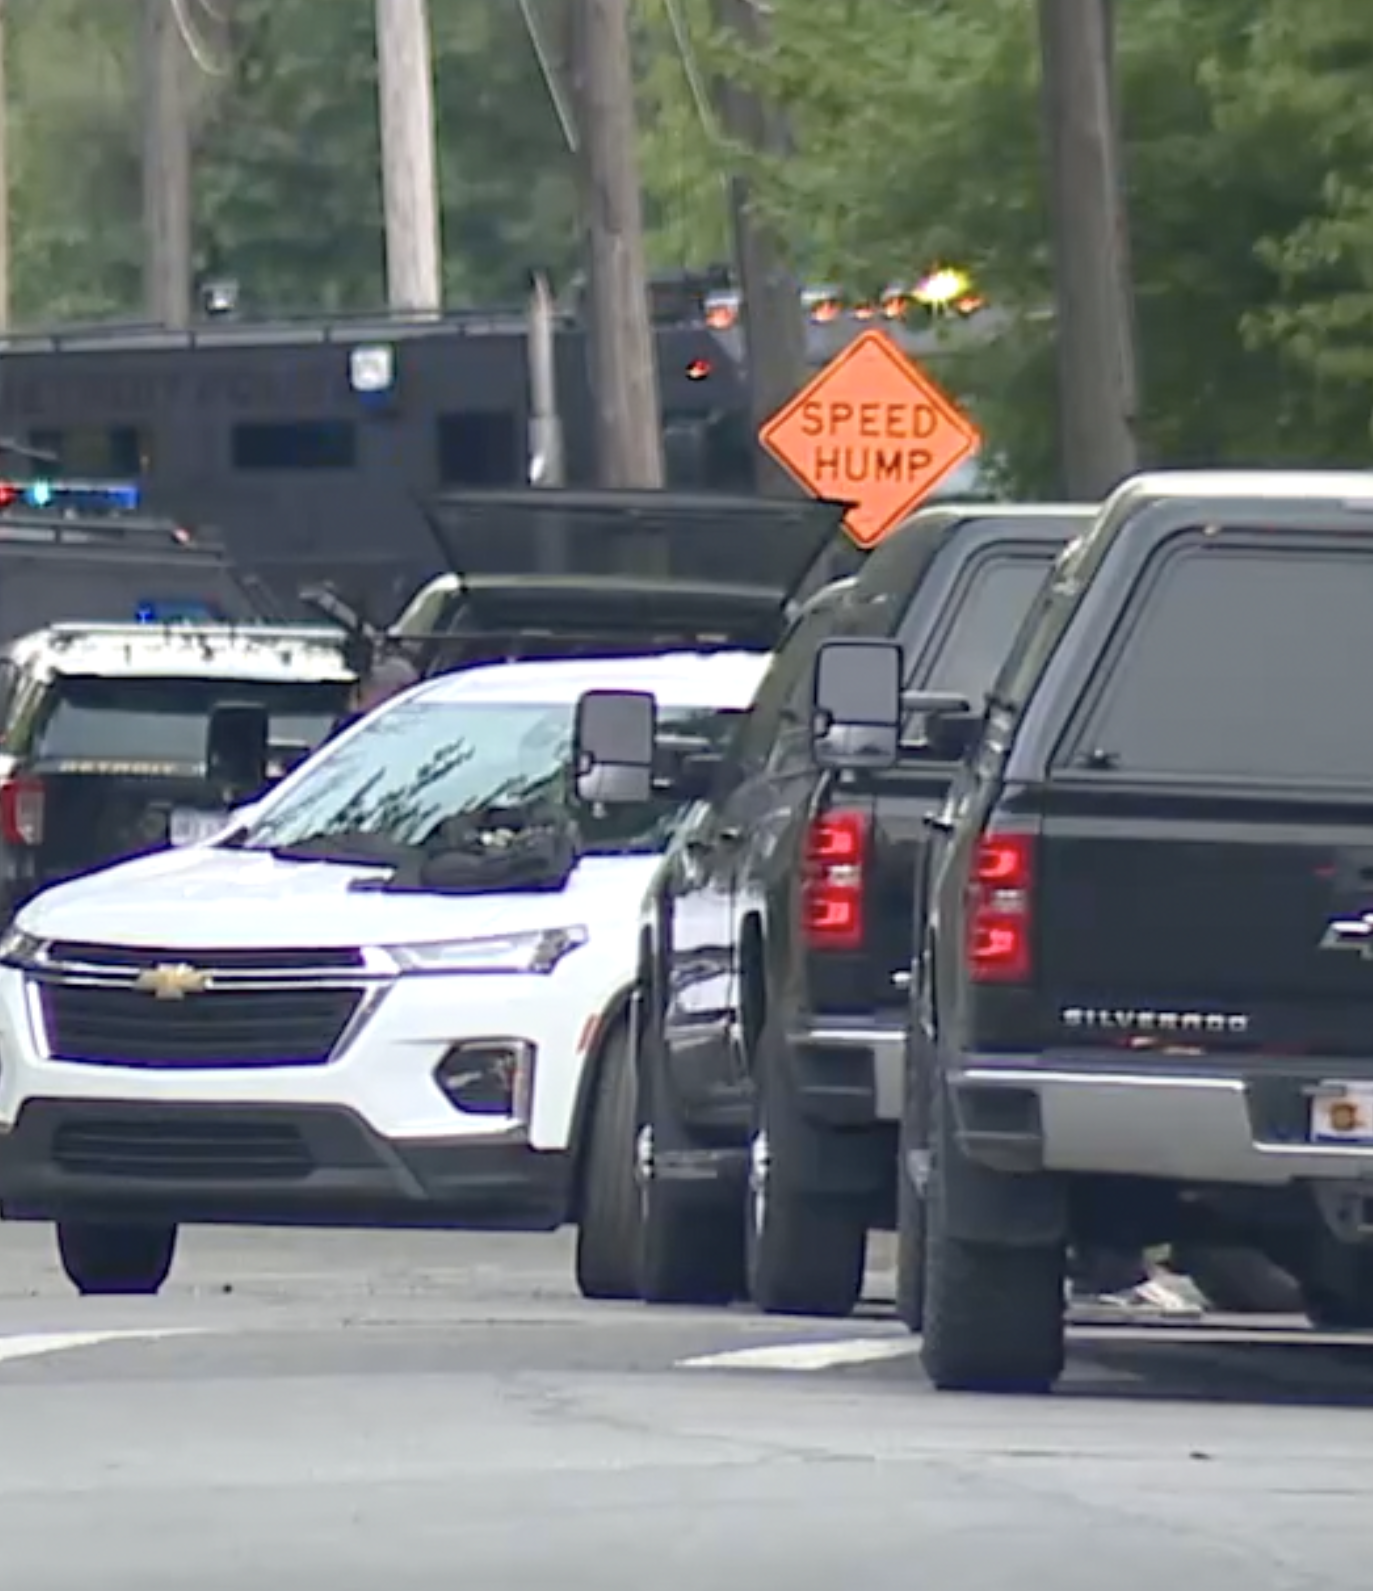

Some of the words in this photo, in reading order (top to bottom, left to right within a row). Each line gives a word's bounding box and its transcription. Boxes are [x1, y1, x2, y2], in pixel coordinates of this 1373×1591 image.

[800, 401, 938, 439] SPEED
[814, 446, 933, 483] HUMP
[1062, 1008, 1249, 1033] SILVERADO
